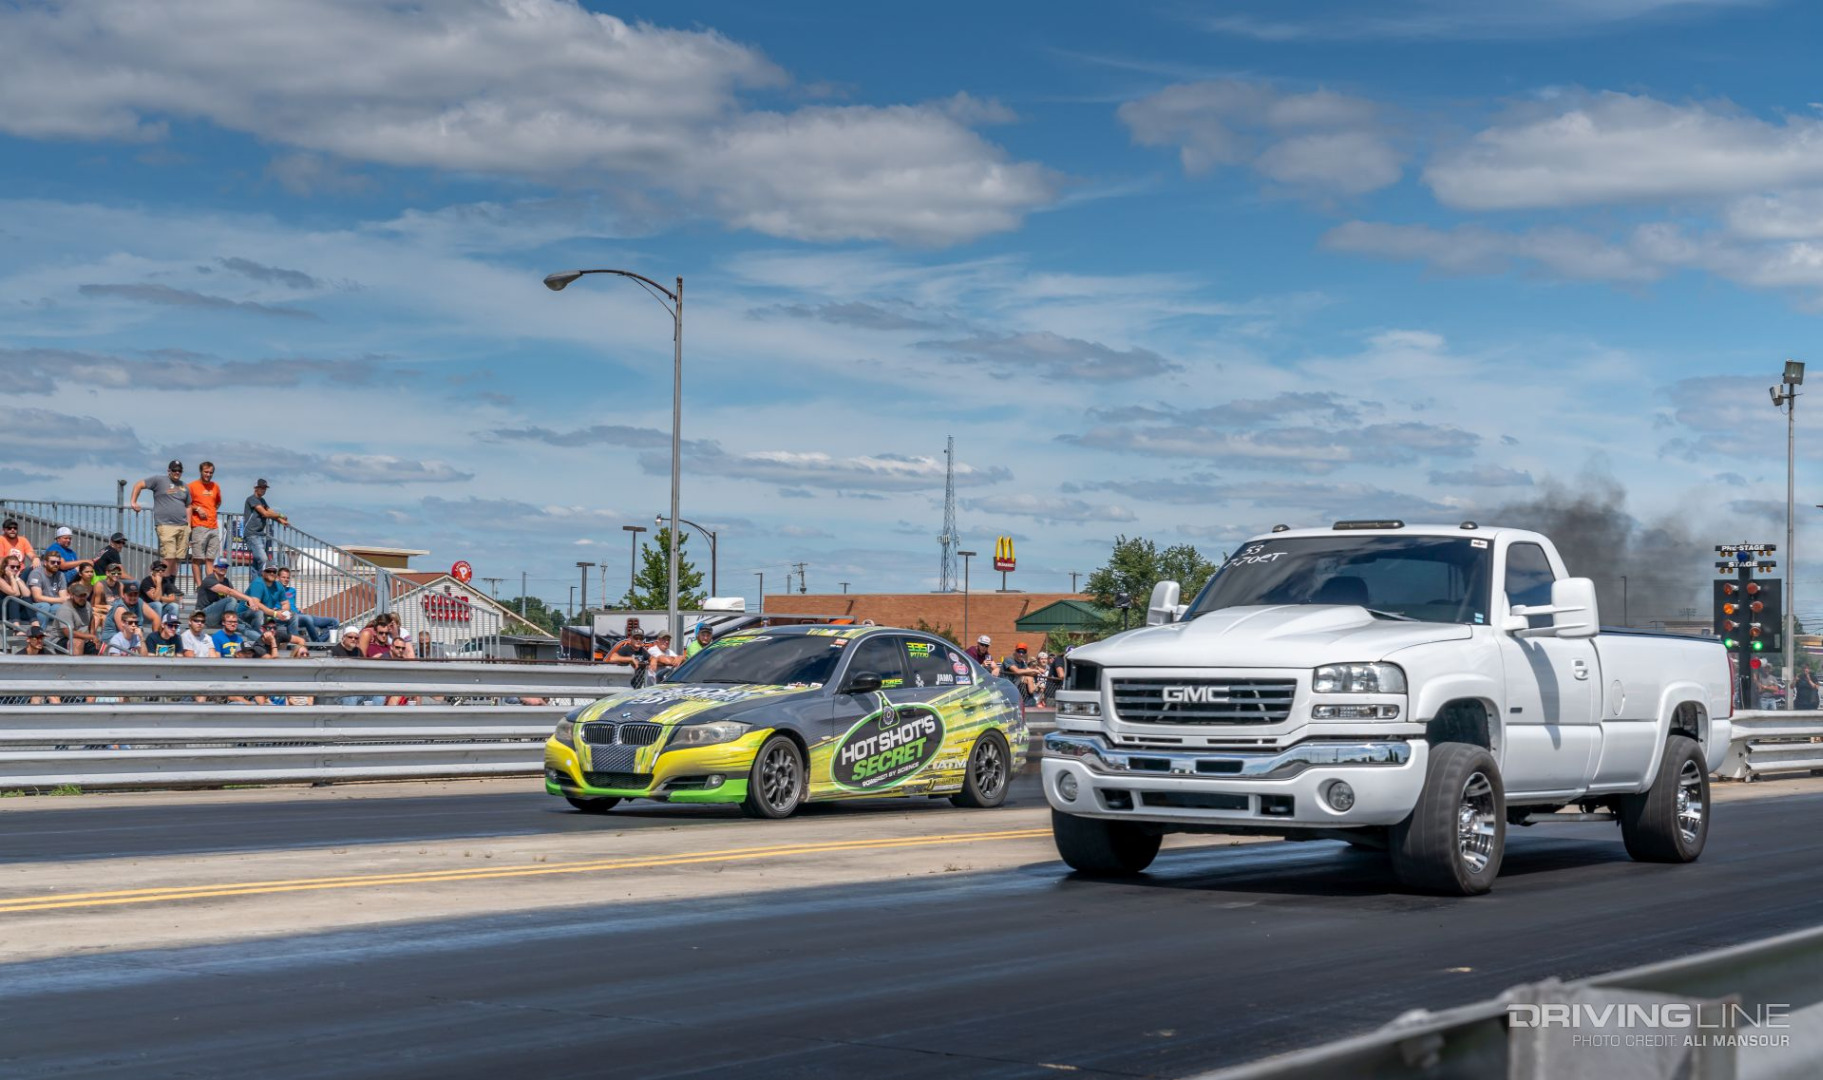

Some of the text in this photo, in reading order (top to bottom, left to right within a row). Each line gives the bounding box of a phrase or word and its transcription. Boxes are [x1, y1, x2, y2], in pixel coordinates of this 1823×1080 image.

[1163, 685, 1229, 702] GMC
[841, 715, 936, 765] HOT SHOT'S
[851, 737, 927, 780] SECRET
[862, 774, 888, 787] POWERED
[889, 770, 897, 778] BY
[897, 762, 920, 774] SCIENCE
